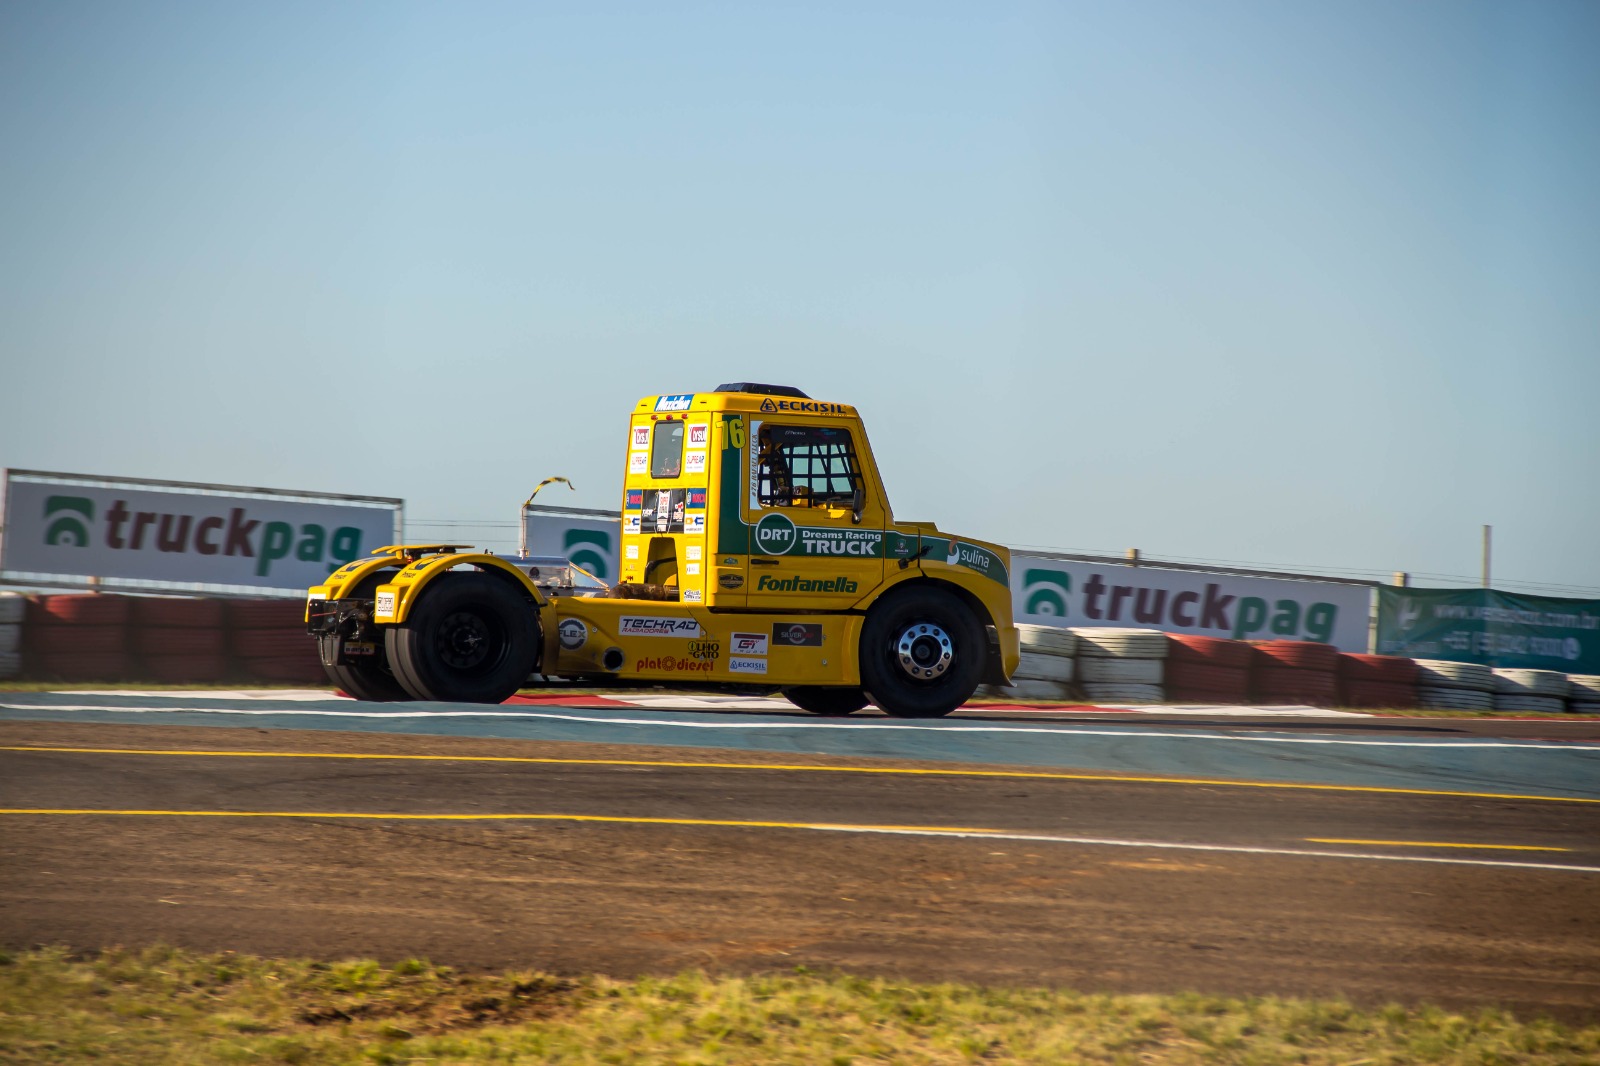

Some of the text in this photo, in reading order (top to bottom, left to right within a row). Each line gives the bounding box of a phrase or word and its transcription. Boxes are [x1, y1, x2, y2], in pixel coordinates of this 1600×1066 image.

[778, 400, 847, 414] ECKISIL
[715, 418, 746, 451] 76
[105, 499, 363, 577] truckpag
[761, 529, 792, 541] DRT
[802, 530, 882, 543] Dreams Racing
[802, 540, 876, 556] TRUCK
[961, 550, 989, 568] sulina
[758, 575, 858, 593] Fontanella
[1083, 574, 1338, 642] truckpag
[623, 618, 698, 632] TECHRAD
[738, 661, 766, 670] ECKISIL
